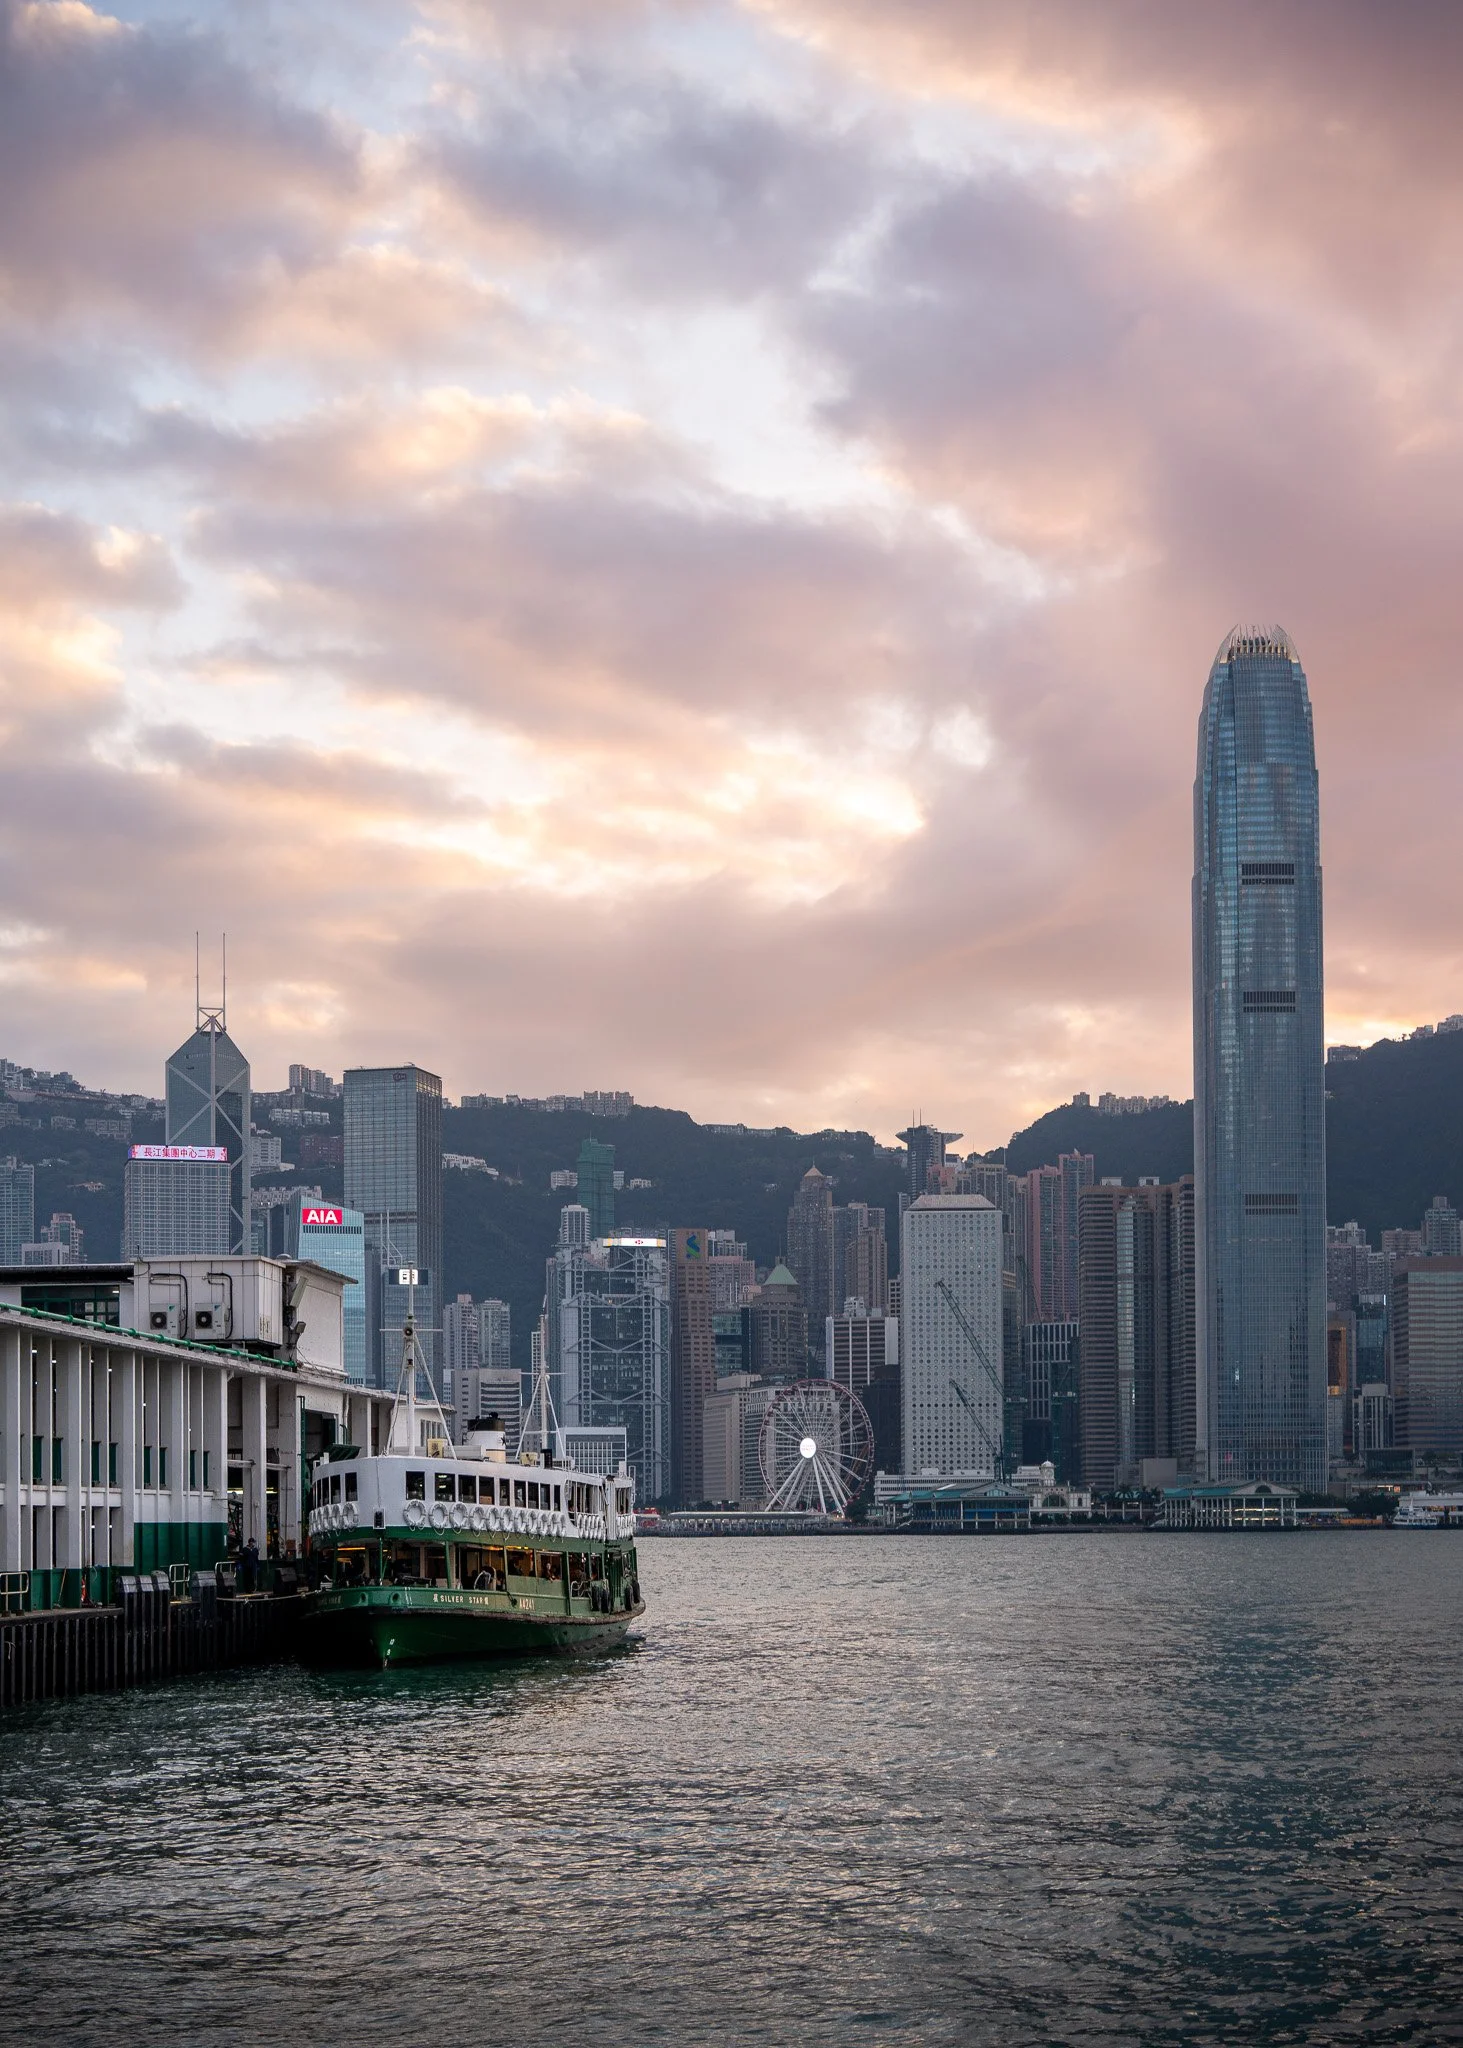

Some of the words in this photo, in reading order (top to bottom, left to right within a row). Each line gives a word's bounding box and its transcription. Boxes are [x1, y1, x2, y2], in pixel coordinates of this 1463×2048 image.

[143, 1146, 216, 1159] 長江集團中心二期
[306, 1209, 339, 1224] AIA
[440, 1594, 464, 1603] SILVER
